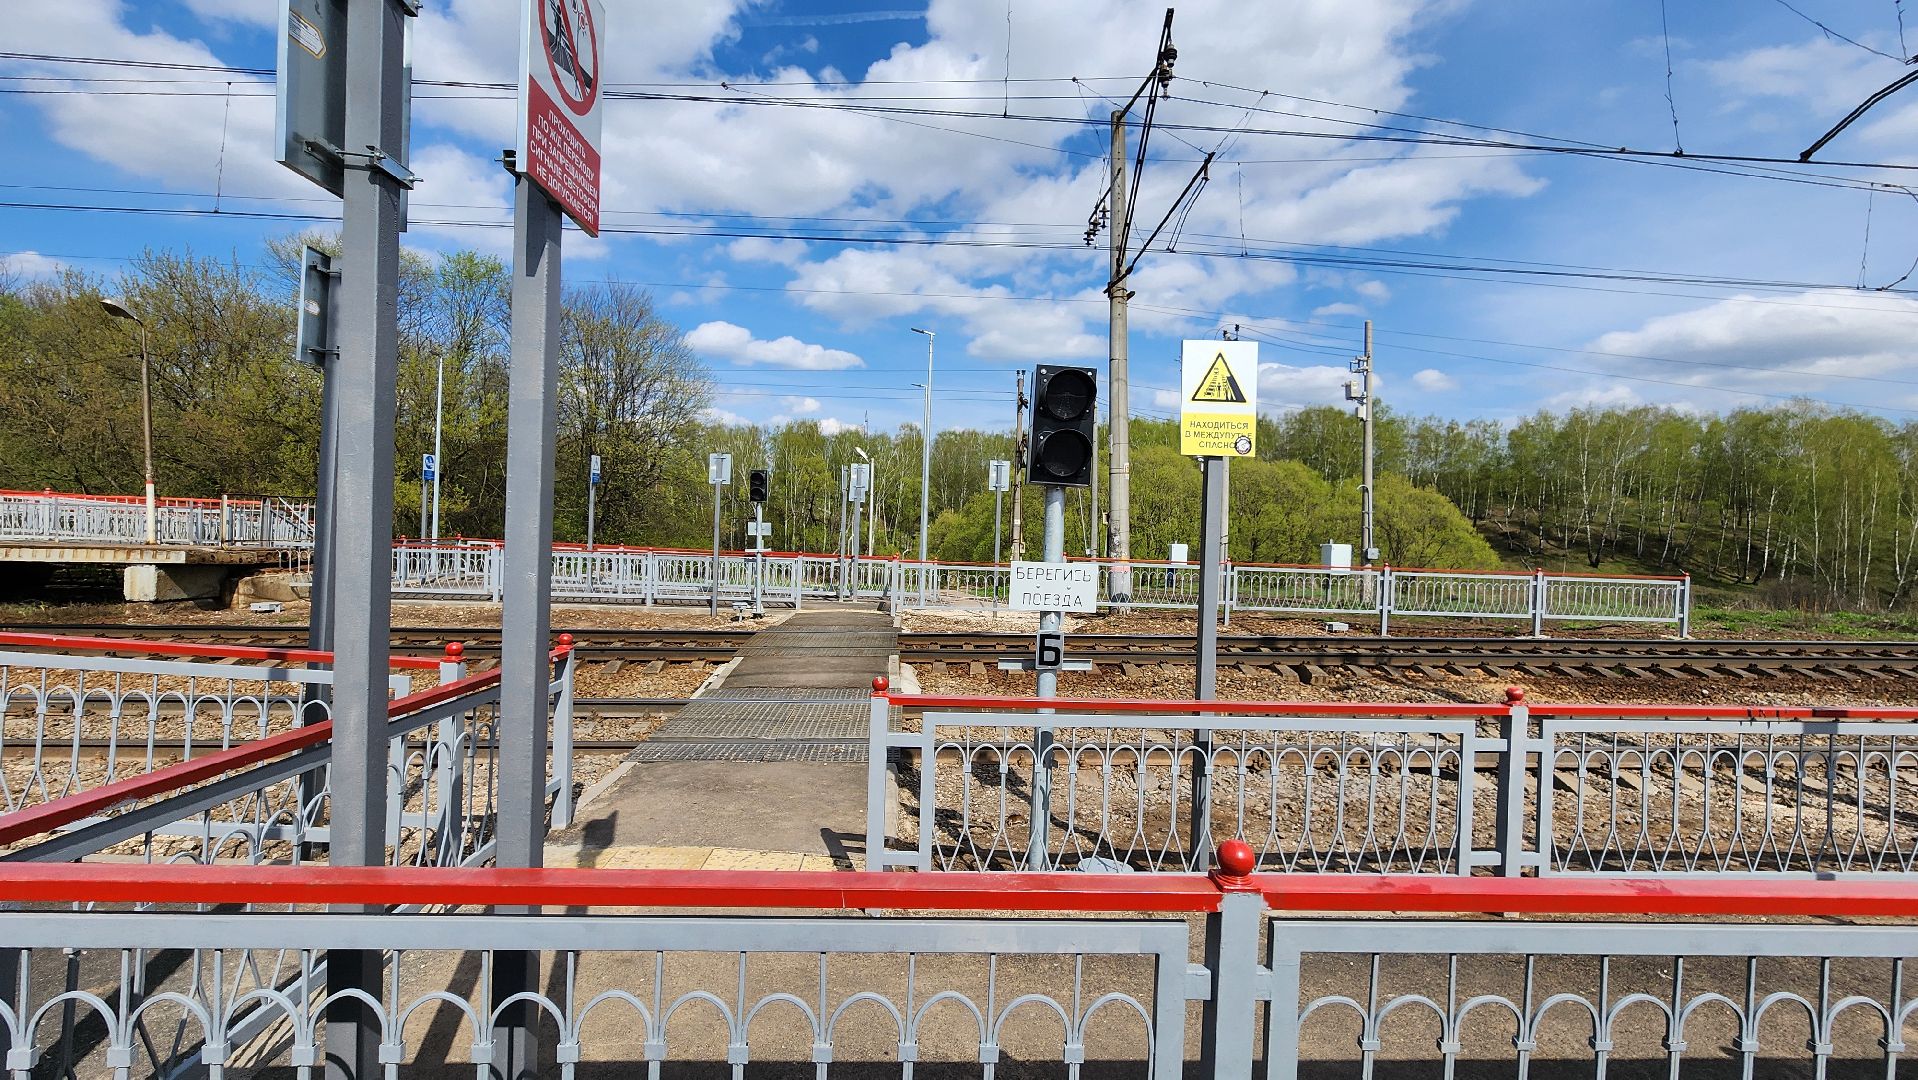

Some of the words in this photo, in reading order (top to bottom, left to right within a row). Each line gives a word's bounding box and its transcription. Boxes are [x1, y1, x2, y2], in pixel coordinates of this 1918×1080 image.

[538, 114, 549, 133] ПО
[563, 142, 595, 181] ПЕРЕХОДУ
[548, 109, 586, 159] ПРОХОДИТЬ
[530, 141, 562, 180] СИГНАЛЕ
[563, 173, 599, 216] СВЕТОФОРА
[532, 125, 547, 149] ПРИ
[548, 143, 598, 200] ЗАПРЕЩАЮЩЕМ
[536, 163, 547, 181] НЕ
[547, 176, 594, 225] ДОПУСКАЕТСЯ!
[1189, 421, 1249, 430] НАХОДИТЬСЯ
[1193, 431, 1252, 440] МЕЖДУПУТЕ
[1016, 566, 1091, 582] БЕРЕГИСЬ
[1022, 592, 1083, 607] ПОЕЗДА
